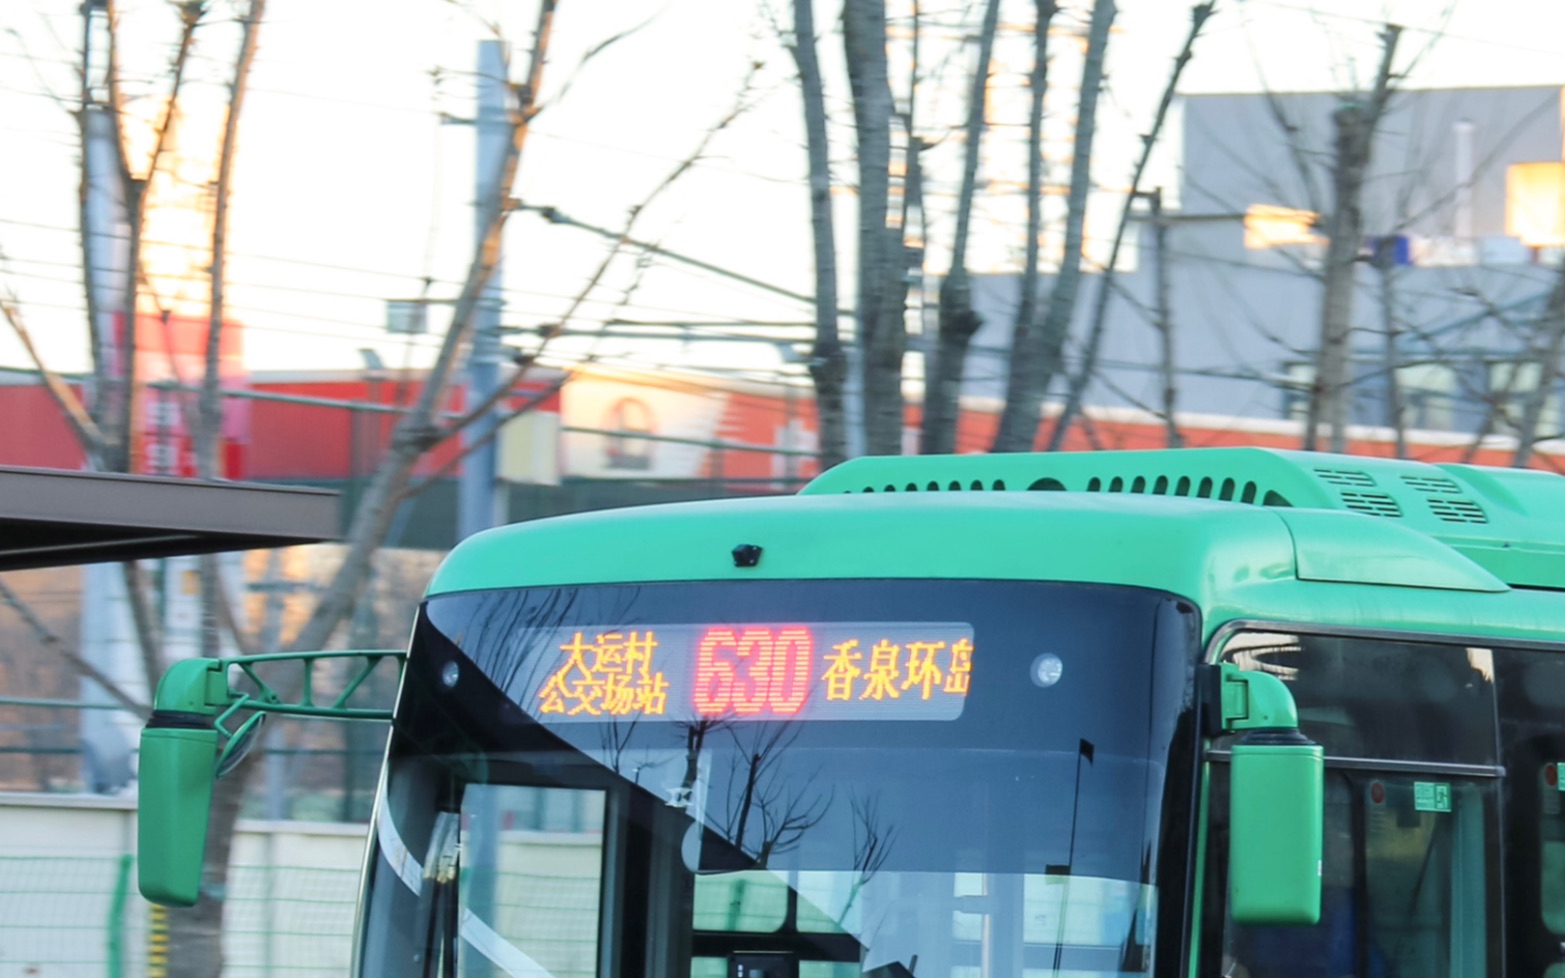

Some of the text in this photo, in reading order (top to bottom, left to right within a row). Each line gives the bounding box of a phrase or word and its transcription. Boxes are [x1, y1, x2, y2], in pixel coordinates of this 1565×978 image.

[560, 631, 658, 682] 大运村
[693, 626, 814, 716] 630
[821, 637, 975, 700] 香泉环岛
[539, 671, 669, 716] 公交场站
